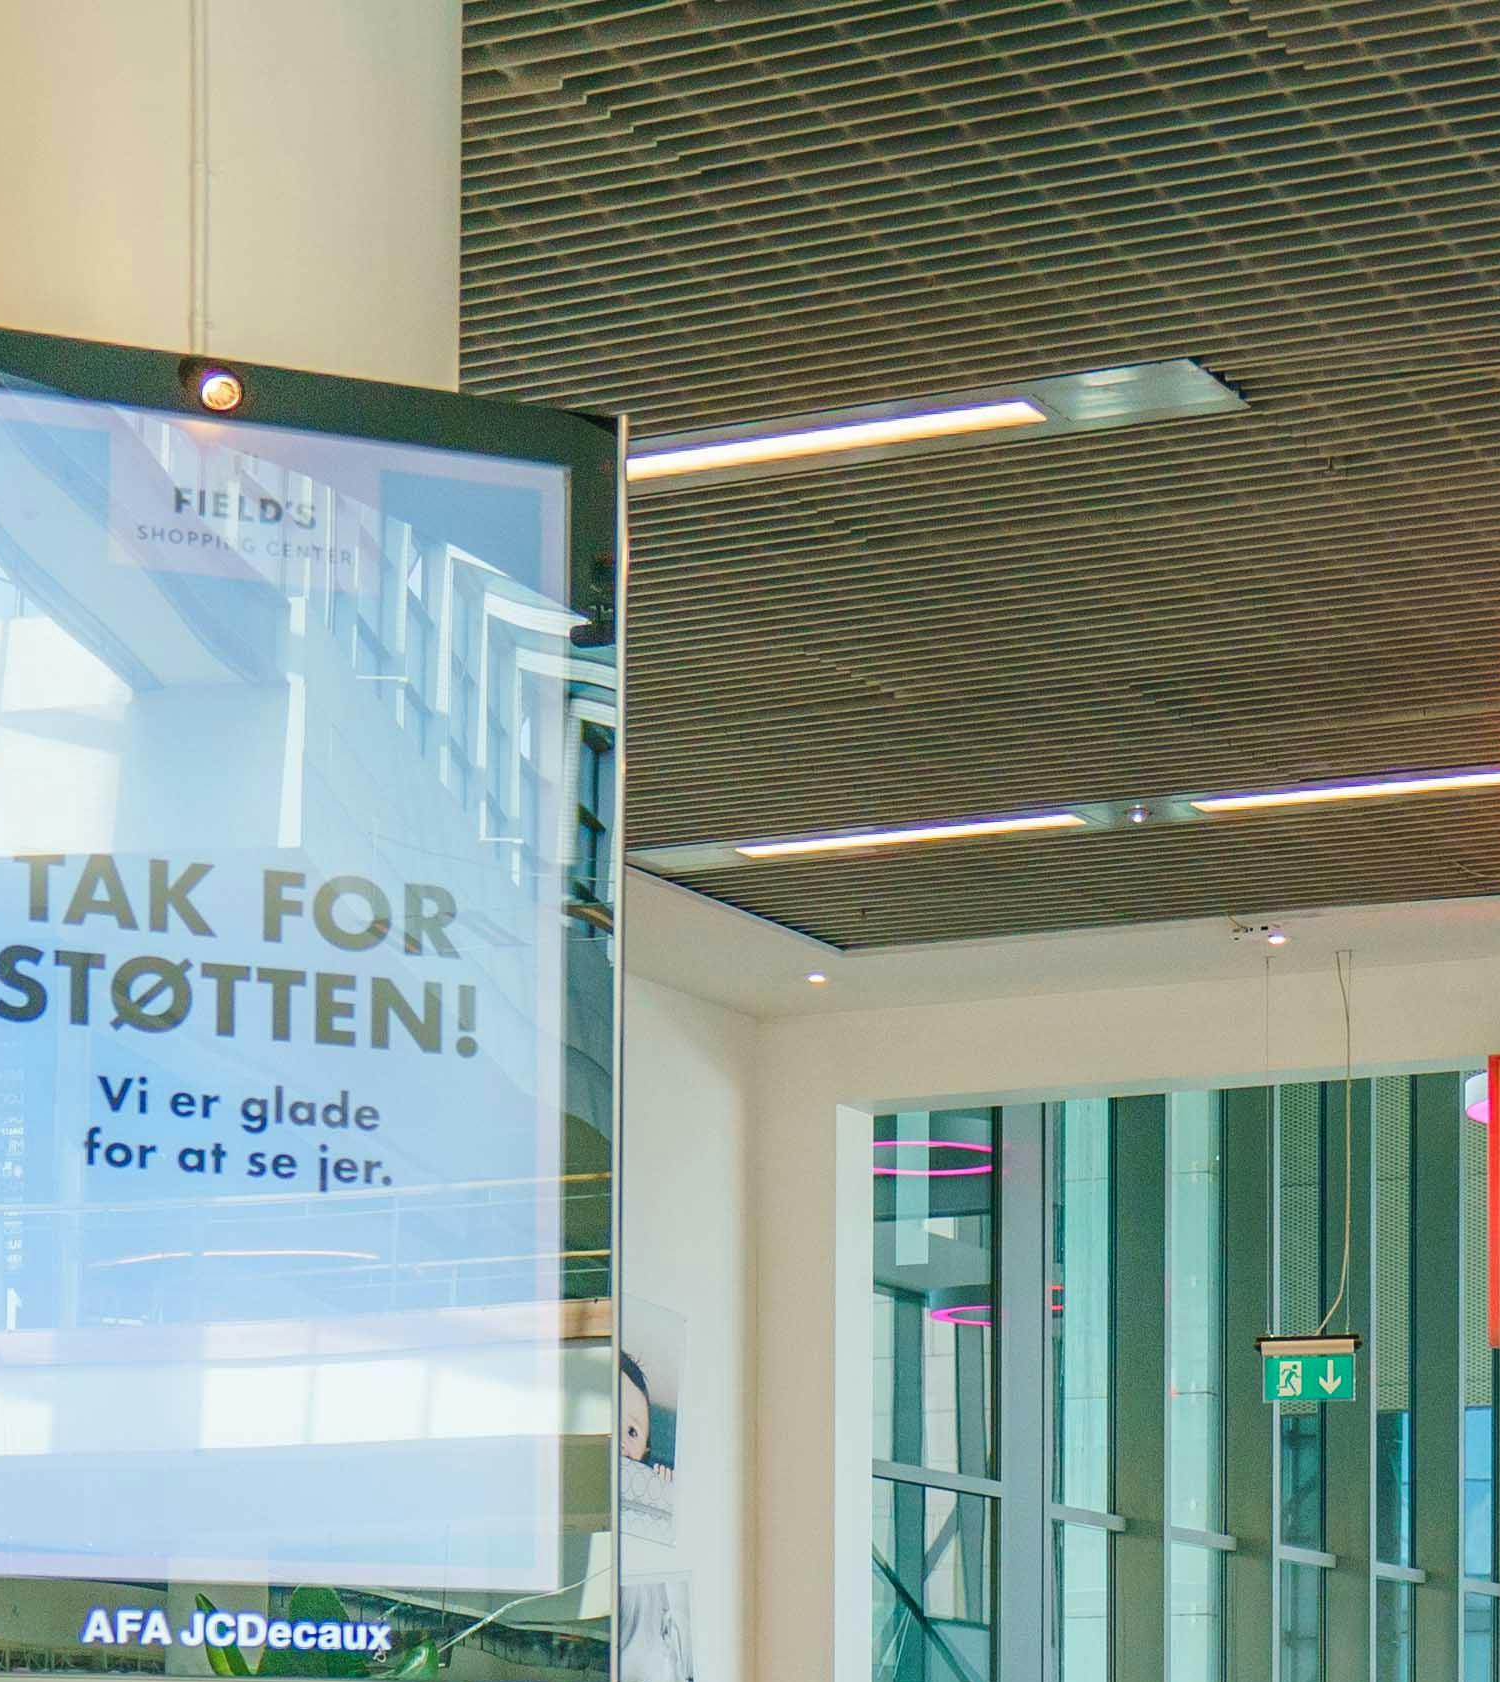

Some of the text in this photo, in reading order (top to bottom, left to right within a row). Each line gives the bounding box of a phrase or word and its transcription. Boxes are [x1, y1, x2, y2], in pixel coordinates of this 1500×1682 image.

[173, 486, 316, 530] FIELD'S
[265, 541, 353, 566] CENTER
[13, 853, 460, 959] TAK FOR
[99, 1073, 382, 1135] Vi er glade
[83, 1128, 394, 1194] for at se jer.
[82, 1608, 392, 1653] AFA JCDecaux
